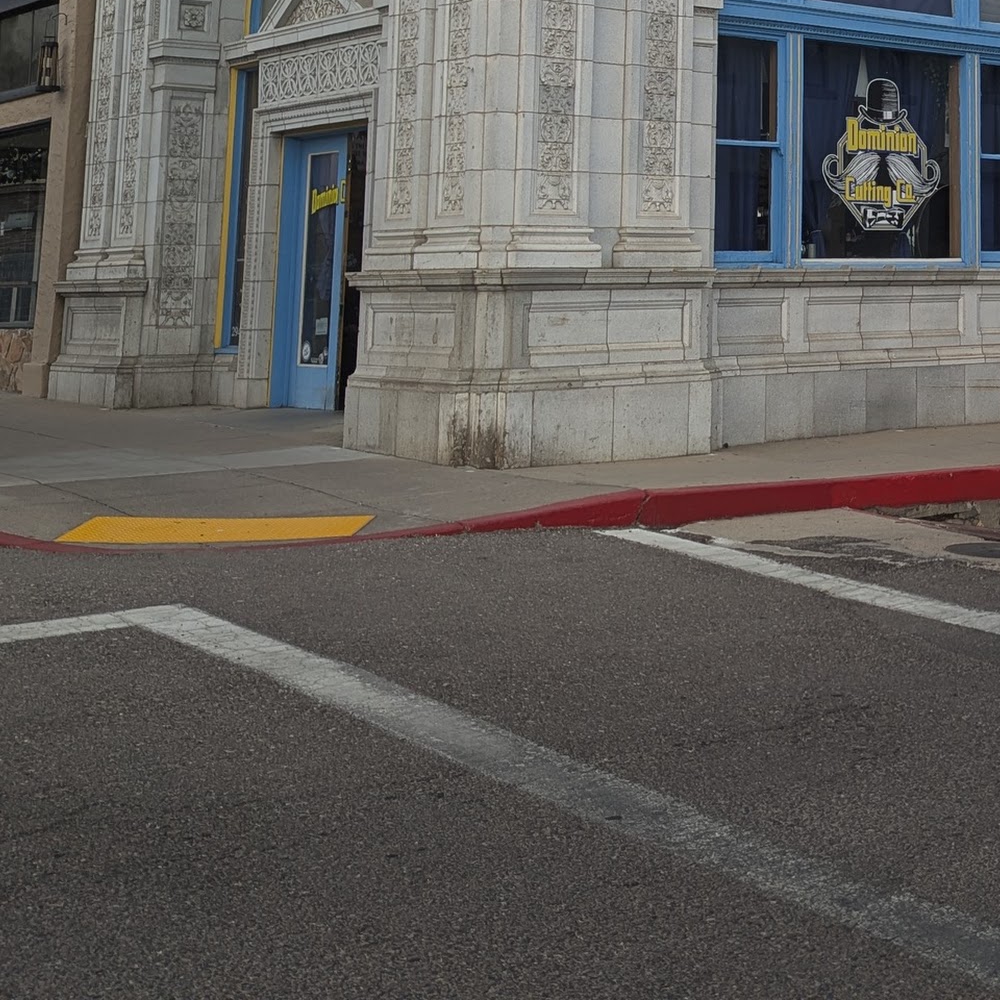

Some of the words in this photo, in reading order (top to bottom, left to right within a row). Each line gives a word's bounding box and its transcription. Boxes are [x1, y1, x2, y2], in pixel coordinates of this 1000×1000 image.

[846, 118, 917, 155] Dominion
[311, 184, 339, 214] Dominion
[845, 176, 892, 207] Cutting
[896, 178, 917, 203] Co.
